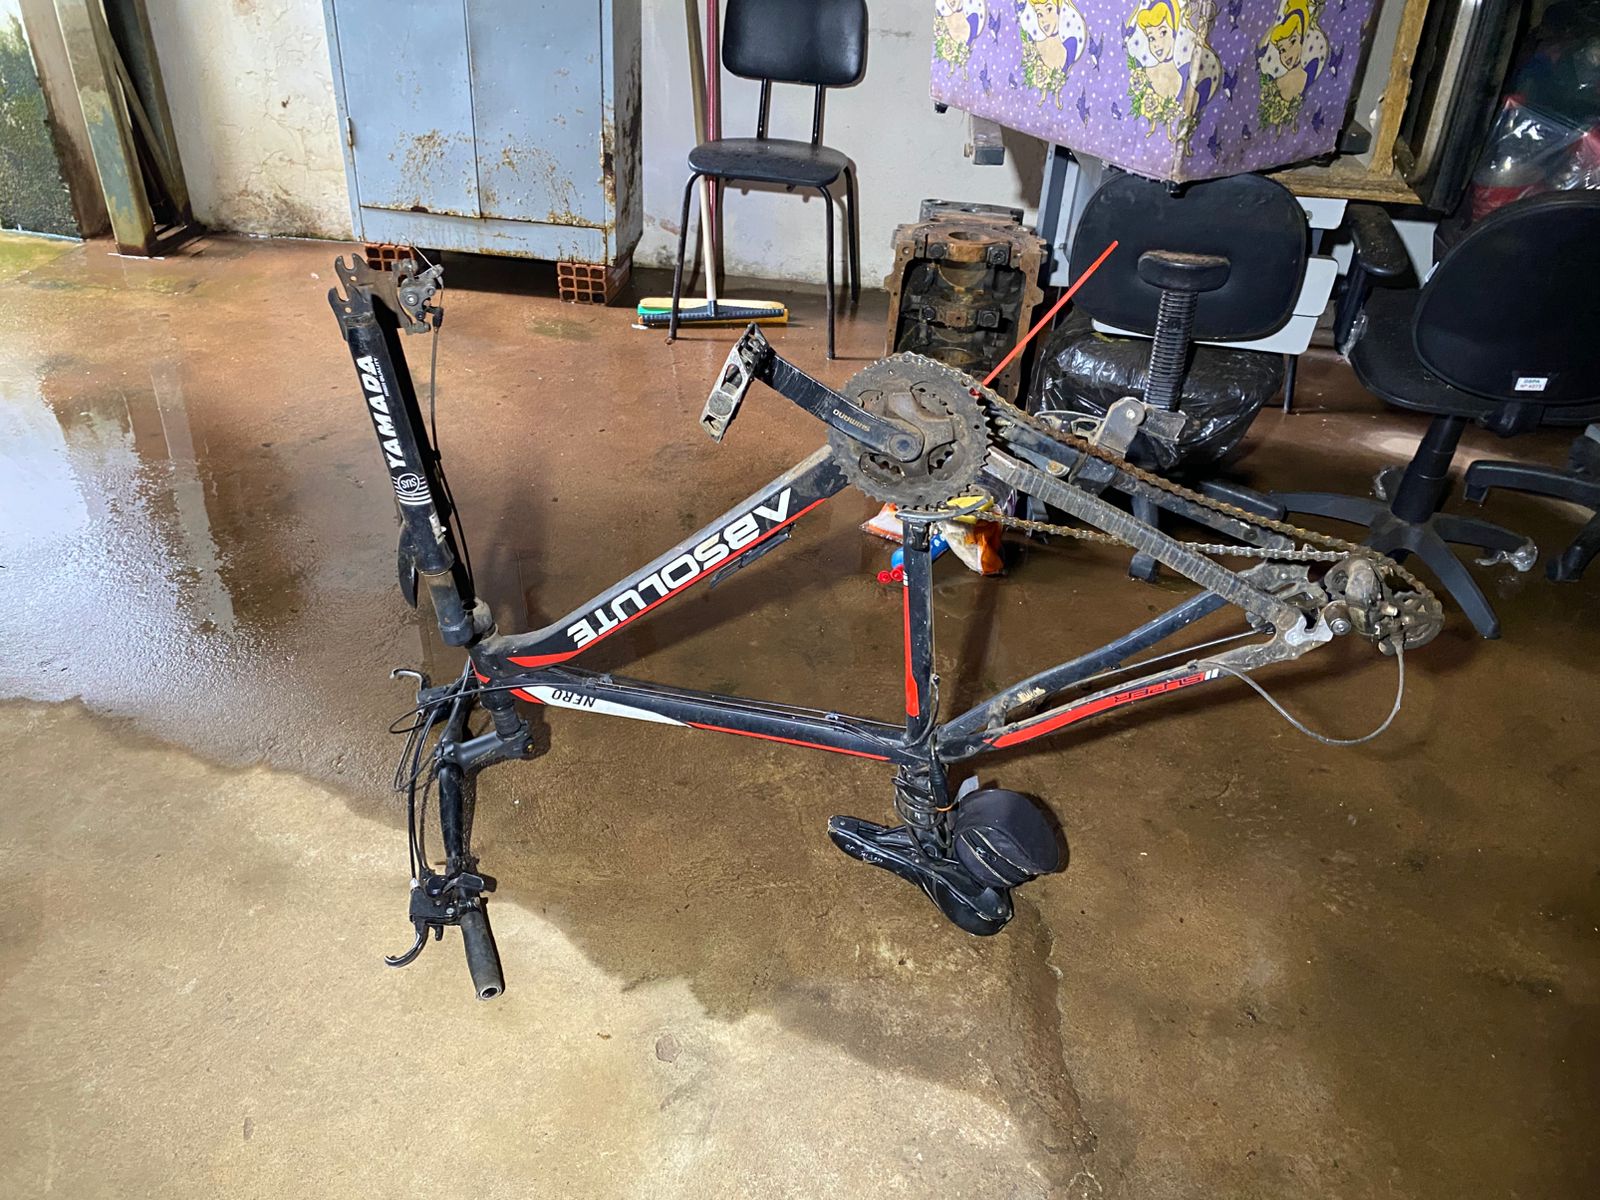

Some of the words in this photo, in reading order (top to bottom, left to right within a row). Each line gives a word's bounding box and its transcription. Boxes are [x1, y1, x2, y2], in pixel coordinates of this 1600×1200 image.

[373, 357, 386, 383] QUALITY
[356, 355, 407, 469] YAMADA
[832, 408, 871, 432] SHIMANO
[567, 487, 791, 649] ABSOLUTE
[551, 689, 596, 708] NERO
